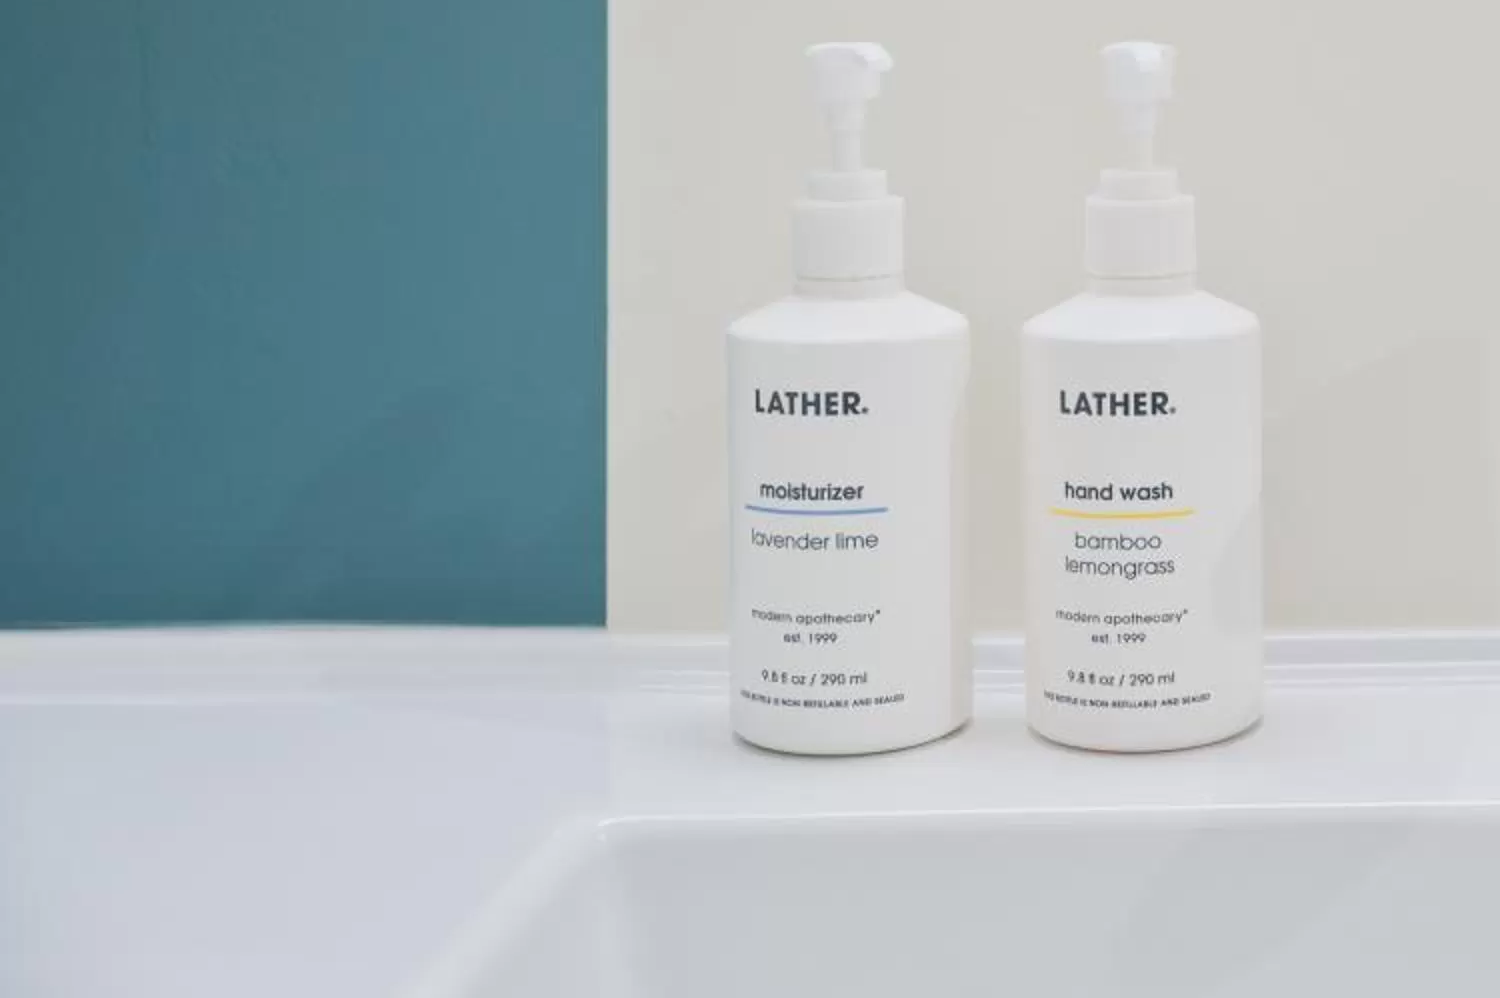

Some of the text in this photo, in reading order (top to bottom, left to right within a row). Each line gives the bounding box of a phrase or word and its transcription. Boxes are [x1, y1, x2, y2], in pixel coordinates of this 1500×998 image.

[754, 388, 869, 416] LATHER.
[1059, 389, 1177, 416] LATHER.
[758, 481, 865, 501] moisturizer
[1063, 481, 1173, 501] hand wash
[751, 527, 879, 551] lavender lime
[1073, 531, 1162, 551] bamboo
[1064, 555, 1176, 580] lemongrass
[751, 609, 793, 623] modern
[1055, 608, 1101, 625] modern
[808, 632, 838, 644] 1999
[1116, 632, 1147, 644] 1999
[791, 675, 806, 686] oz
[809, 673, 817, 687] /
[820, 673, 846, 687] 290
[849, 671, 868, 686] ml
[1118, 673, 1125, 687] /
[1129, 673, 1155, 687] 290
[1157, 670, 1175, 685] ml
